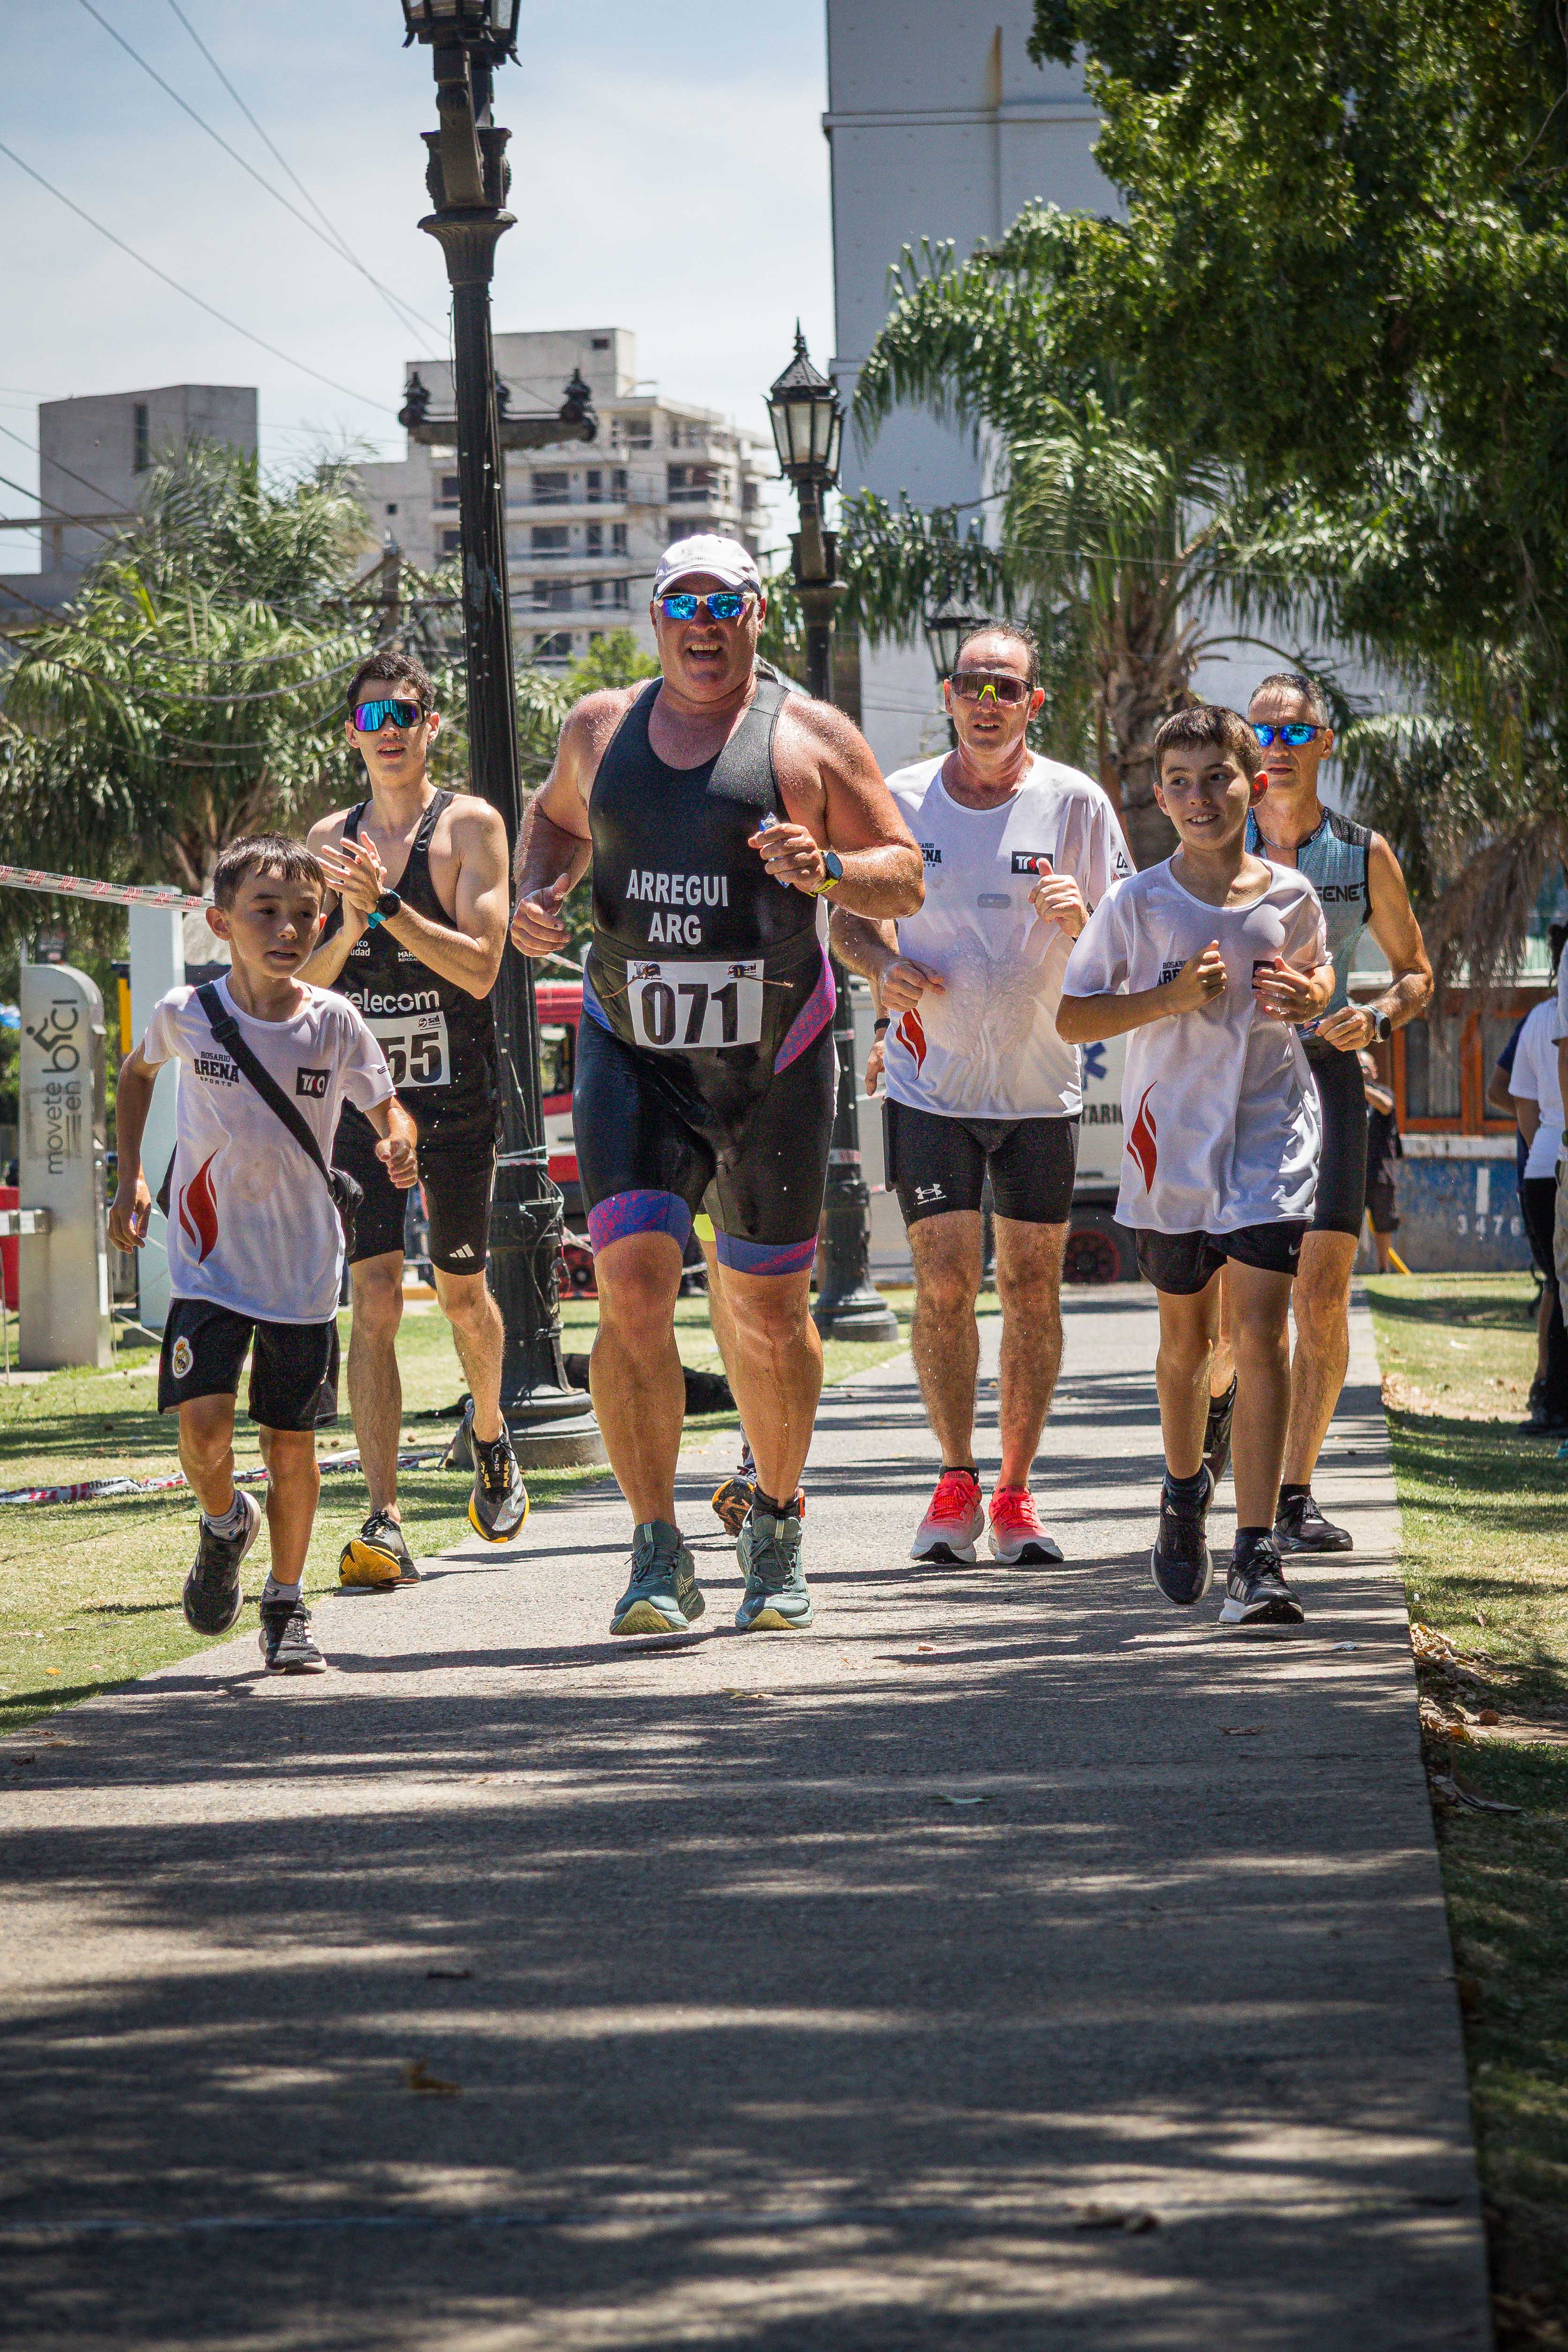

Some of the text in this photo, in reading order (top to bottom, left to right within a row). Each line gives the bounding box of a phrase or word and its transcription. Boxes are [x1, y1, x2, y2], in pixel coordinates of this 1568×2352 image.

[626, 869, 728, 907] ARREGUI
[648, 912, 702, 945] ARG
[641, 981, 738, 1045] 071
[194, 1058, 240, 1084] ARENA
[196, 1051, 231, 1062] ROSARIO
[65, 1080, 81, 1111] en
[200, 1076, 232, 1087] SPORTS
[47, 1081, 63, 1174] movete
